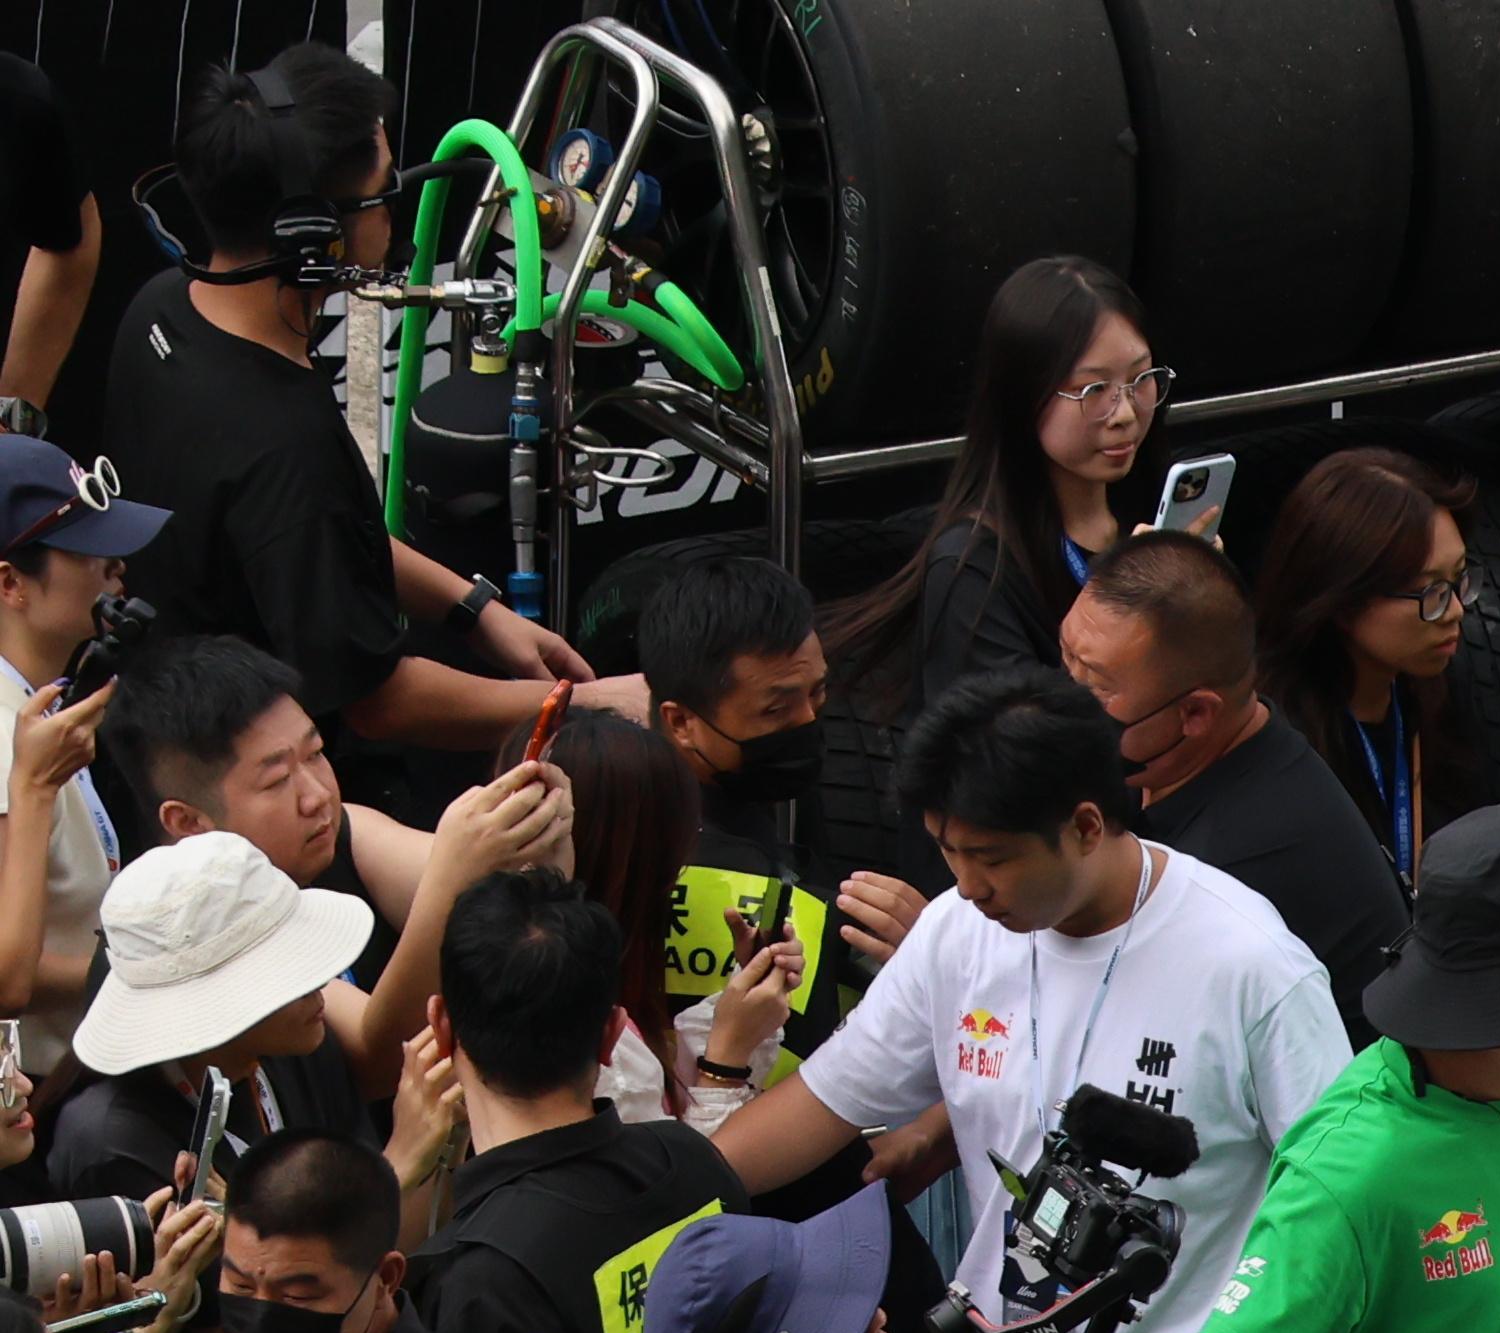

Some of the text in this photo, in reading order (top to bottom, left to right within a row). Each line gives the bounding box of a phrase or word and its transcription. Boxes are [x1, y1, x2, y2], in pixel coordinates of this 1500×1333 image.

[664, 946, 738, 978] AOA
[957, 1042, 1004, 1080] Red Bull
[1423, 1238, 1494, 1281] Red Bull
